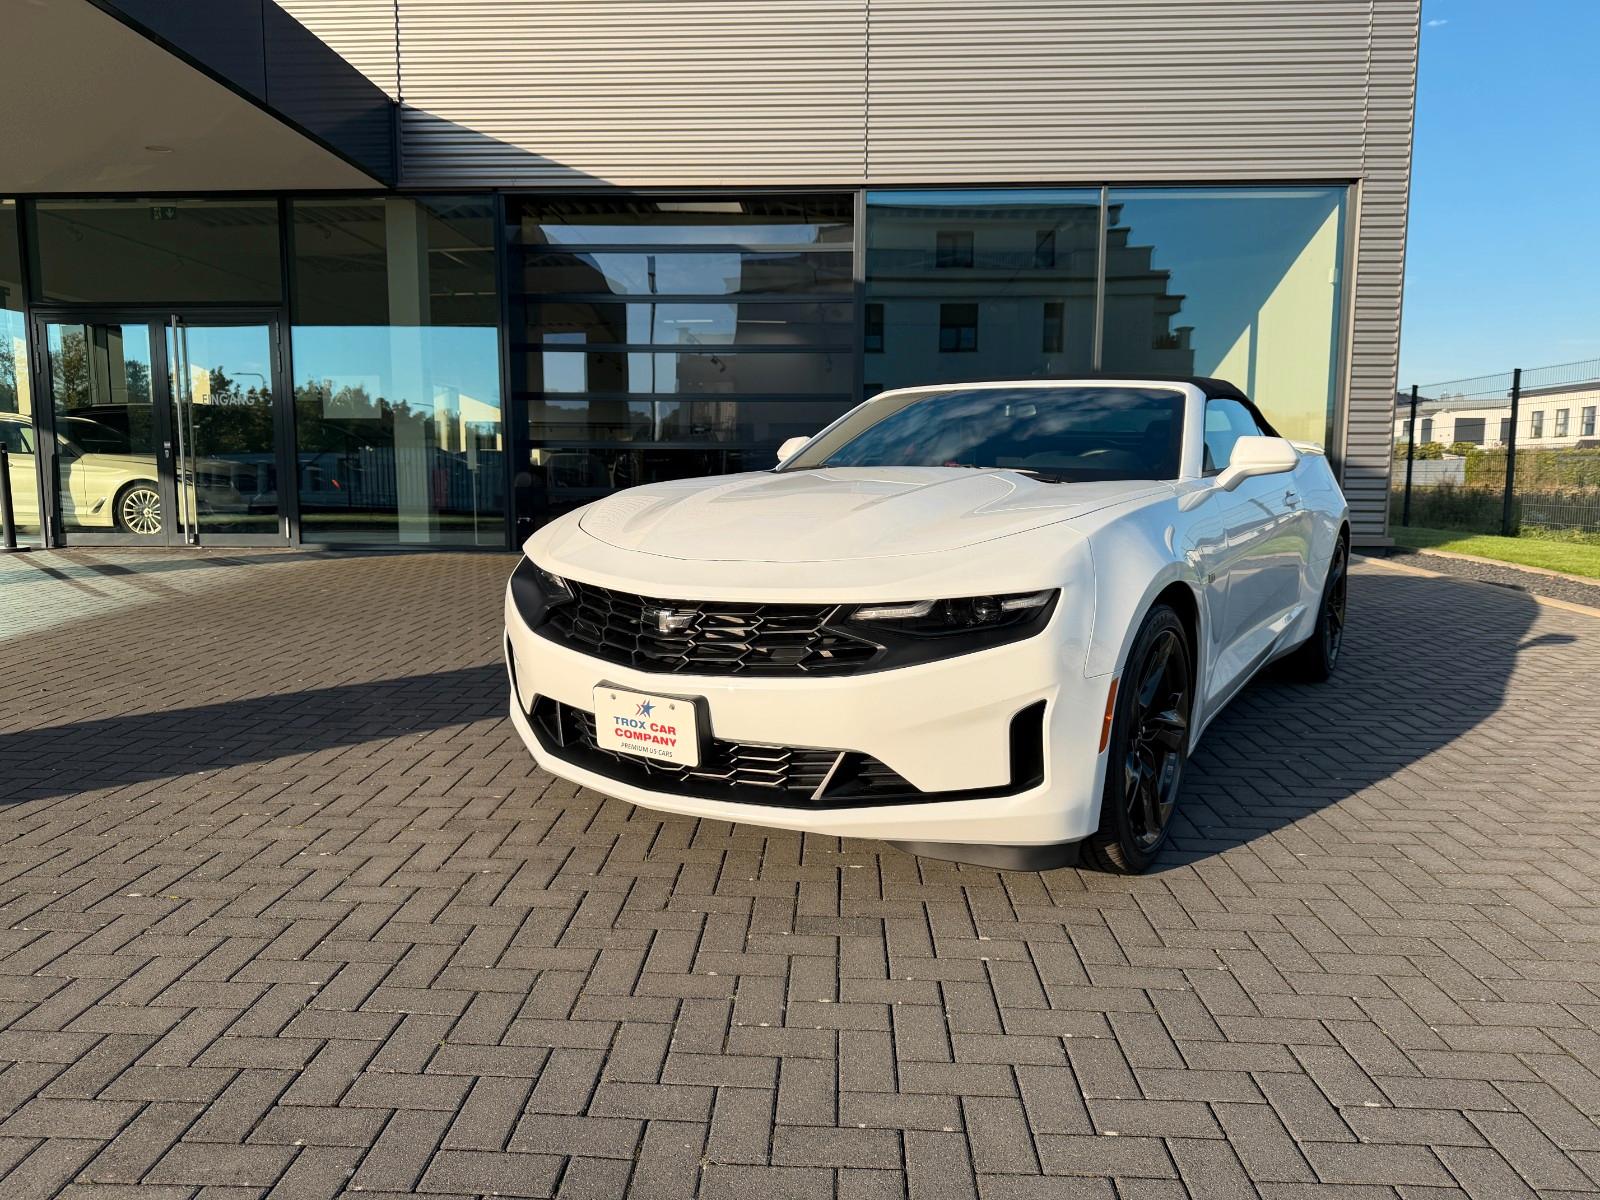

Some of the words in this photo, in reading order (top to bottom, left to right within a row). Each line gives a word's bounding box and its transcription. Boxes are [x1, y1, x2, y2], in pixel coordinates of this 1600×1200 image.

[202, 394, 255, 406] EINGANG
[614, 716, 646, 729] TROX
[650, 723, 676, 735] CAR
[615, 728, 677, 747] COMPANY
[621, 742, 649, 753] PREMIUM
[658, 749, 673, 757] CARS
